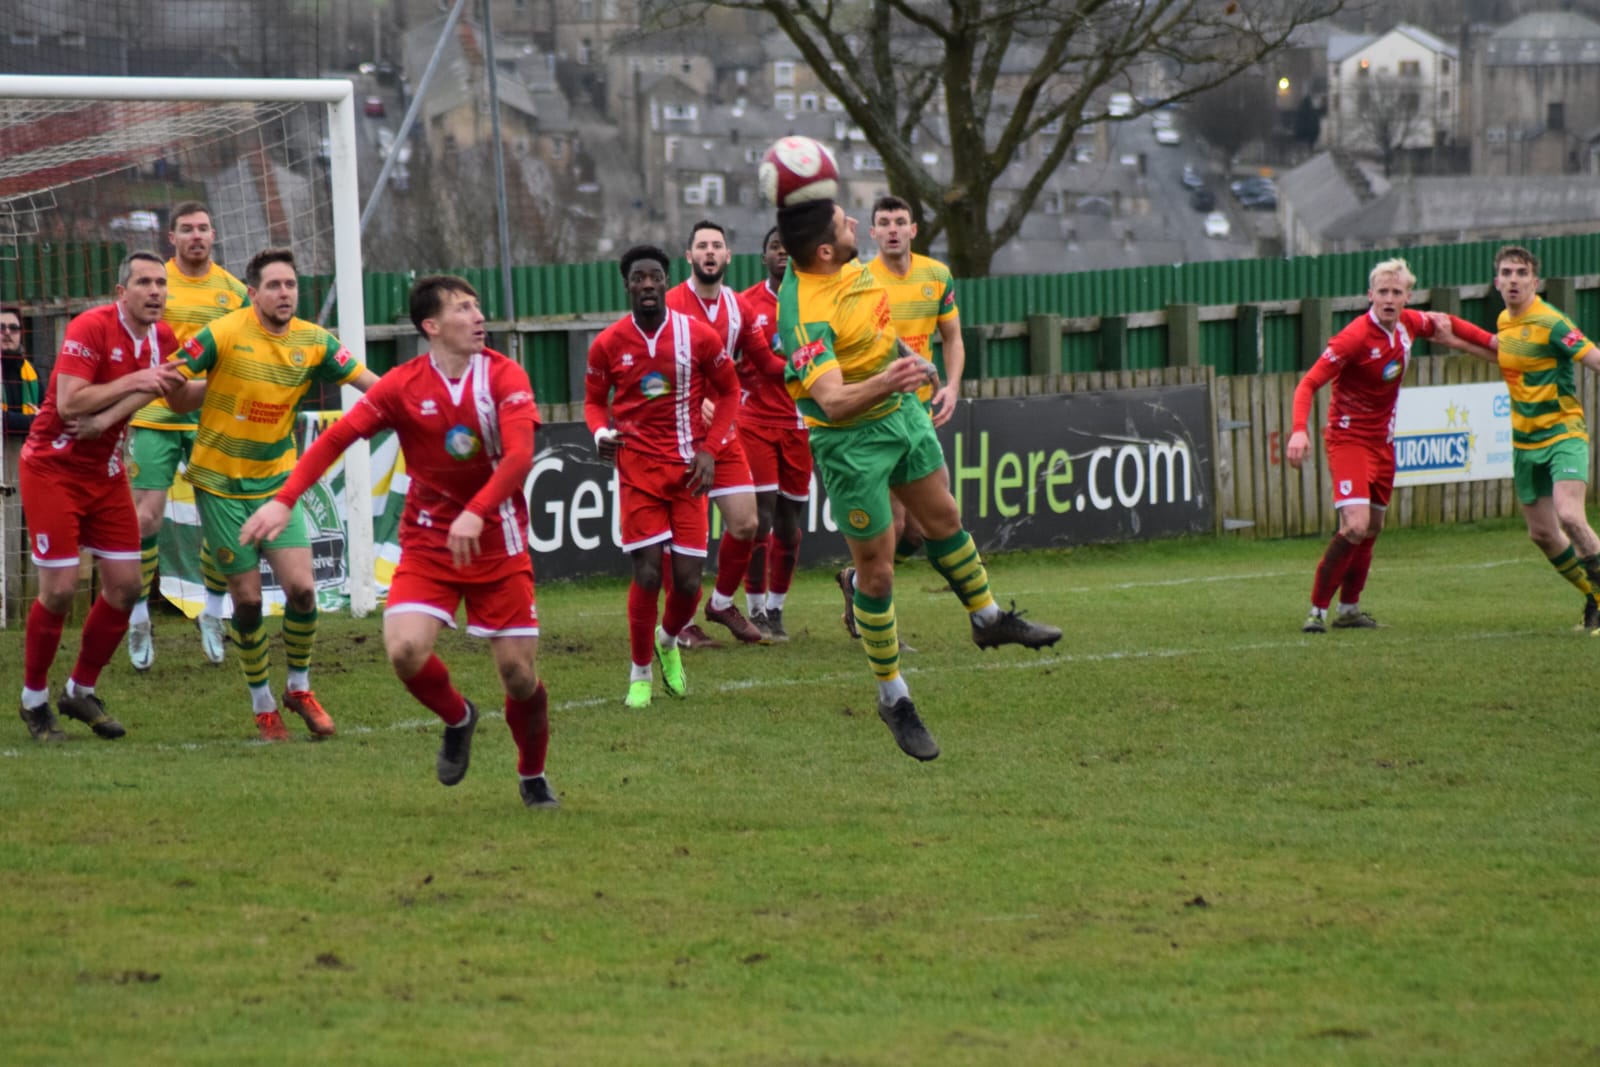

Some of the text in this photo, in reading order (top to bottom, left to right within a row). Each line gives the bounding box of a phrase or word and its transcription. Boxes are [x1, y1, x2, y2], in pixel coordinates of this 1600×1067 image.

[954, 431, 1192, 519] Here.com
[1394, 435, 1466, 468] URONICS
[523, 457, 624, 552] Get
